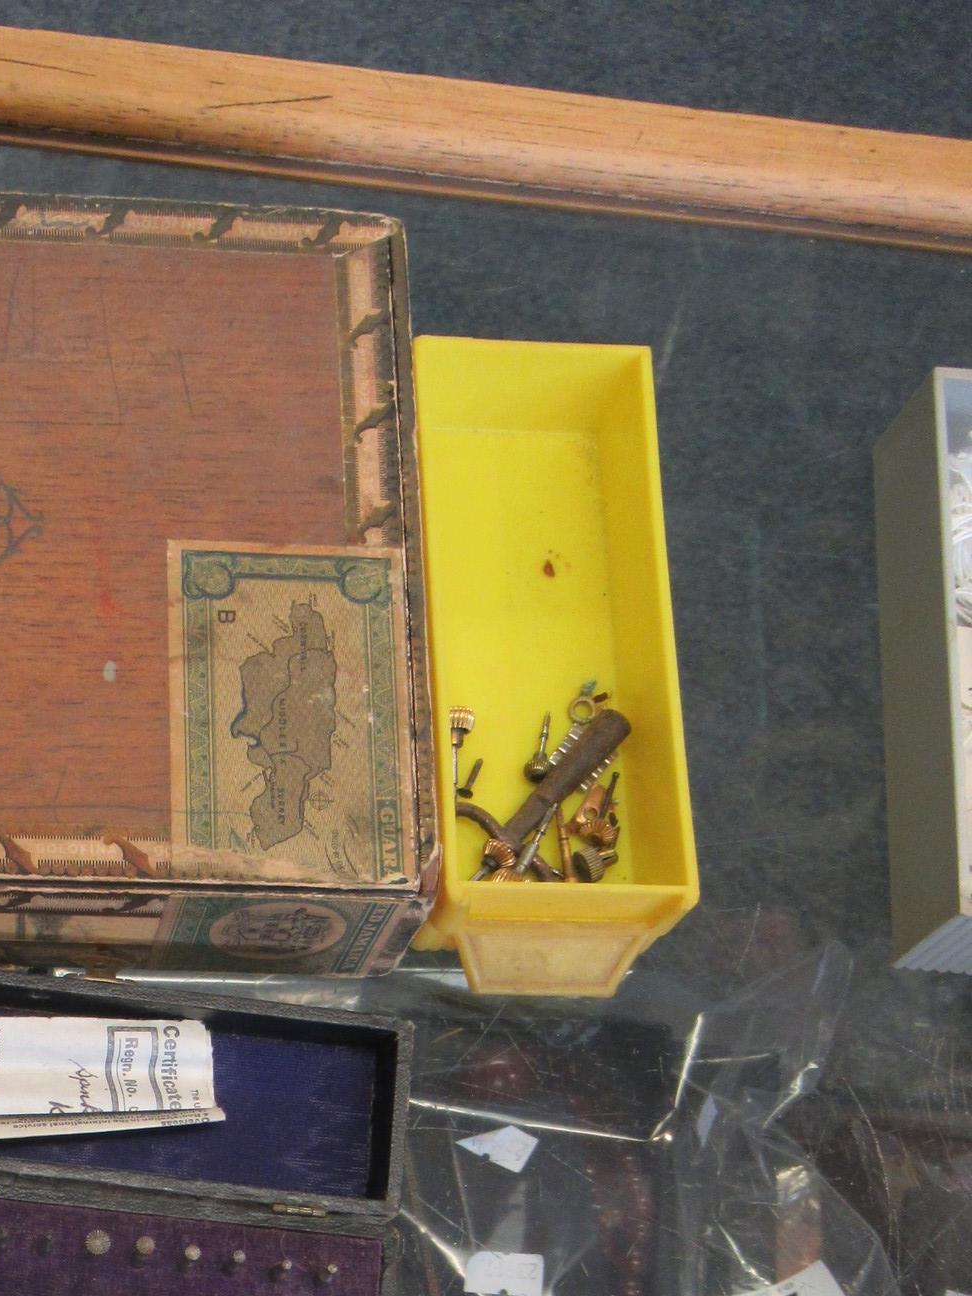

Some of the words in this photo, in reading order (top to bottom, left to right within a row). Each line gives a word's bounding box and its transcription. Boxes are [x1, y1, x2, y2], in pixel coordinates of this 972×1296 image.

[217, 609, 236, 624] B
[120, 1037, 139, 1076] Regn.
[161, 1025, 182, 1109] Certificate
[121, 1078, 139, 1097] No.
